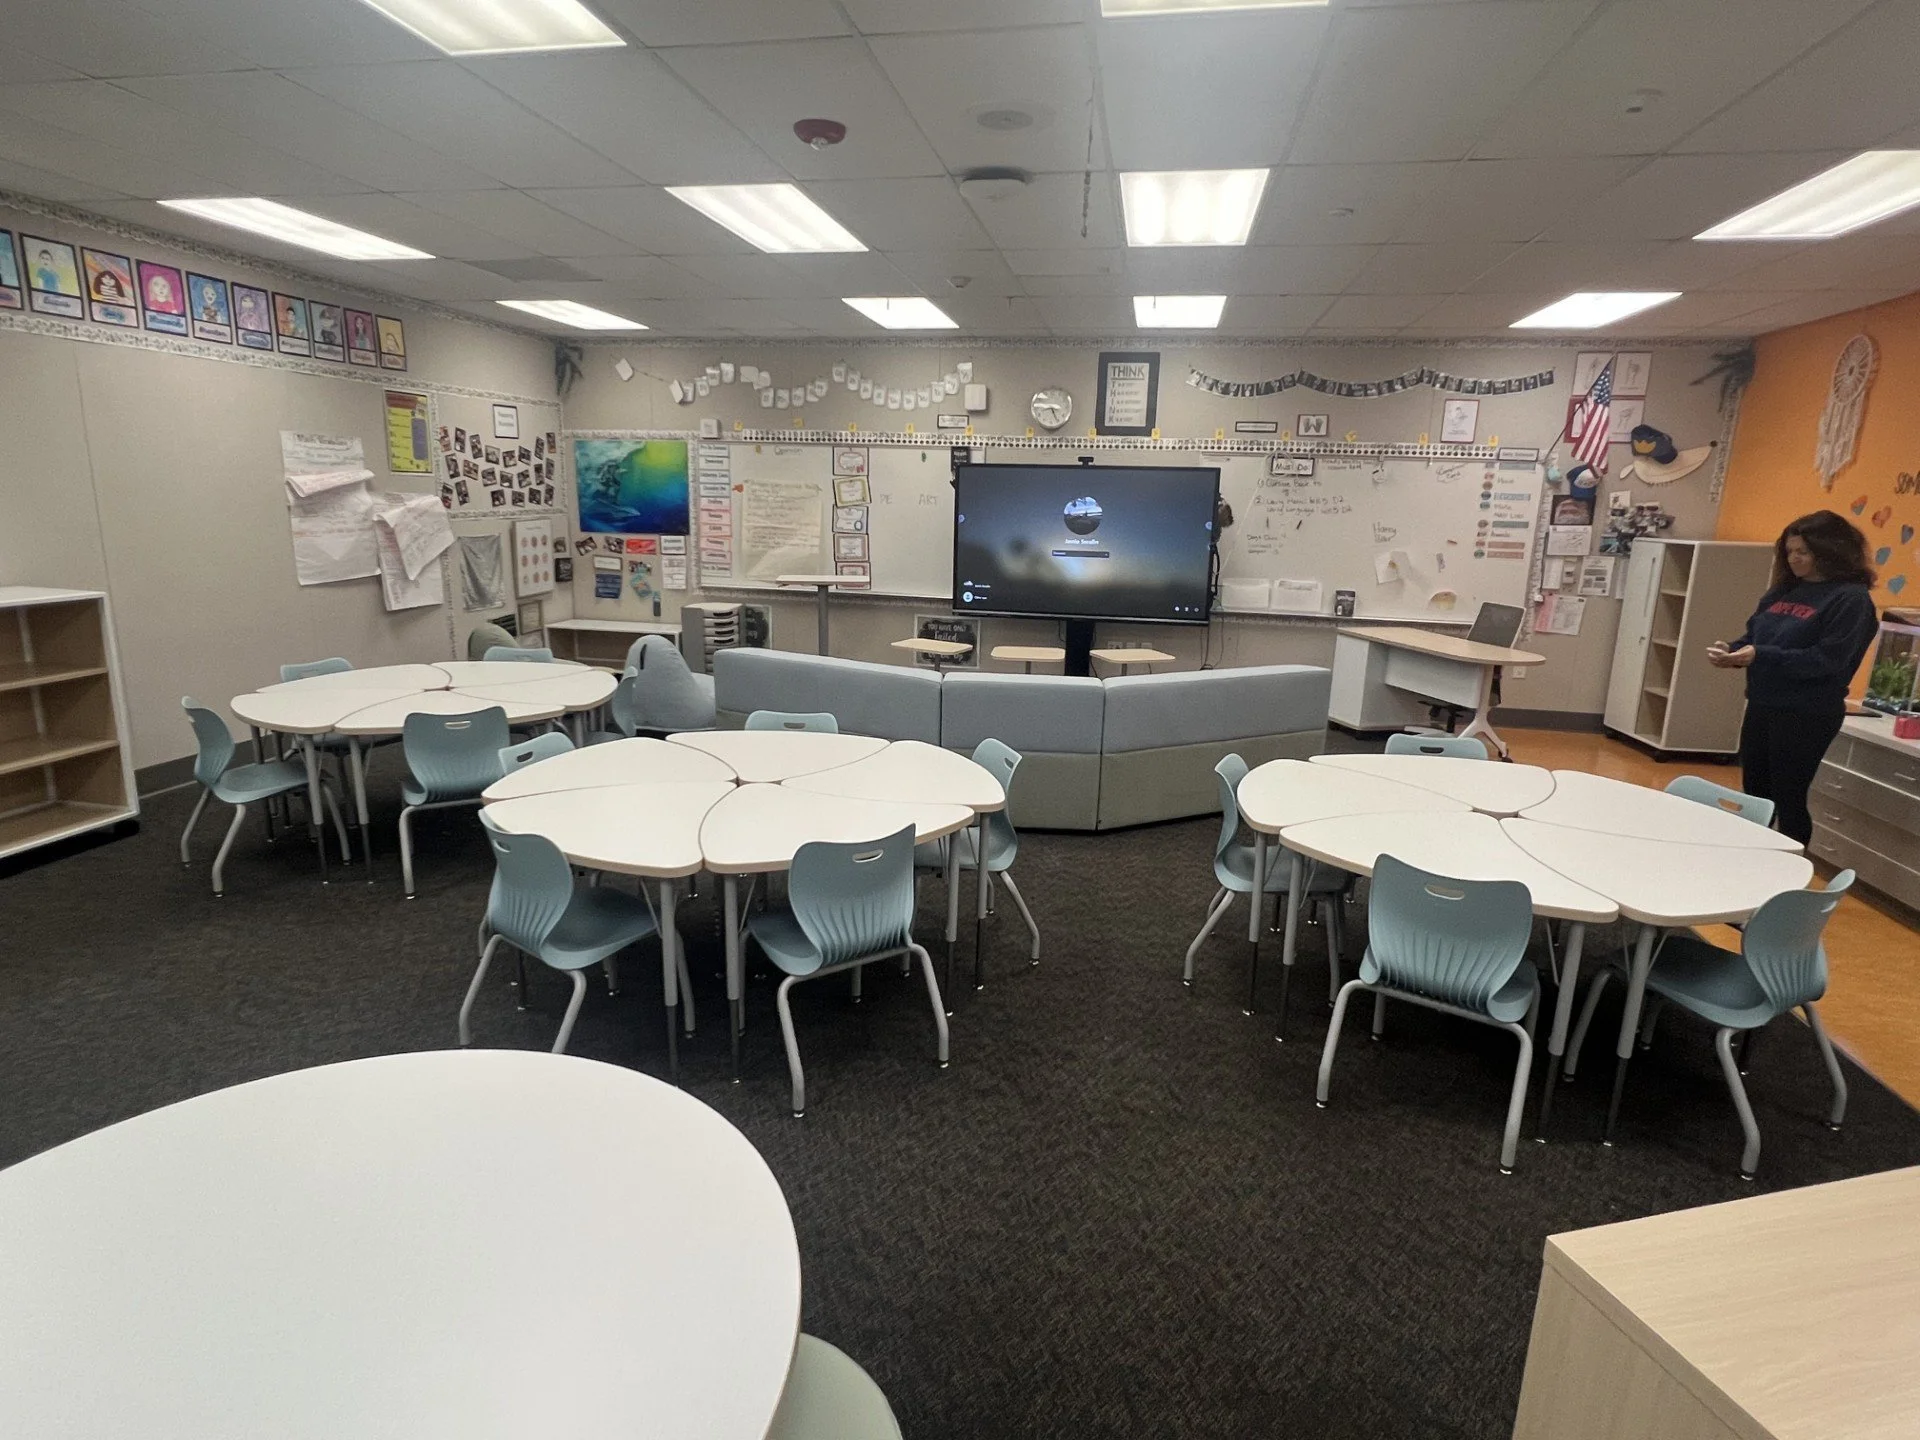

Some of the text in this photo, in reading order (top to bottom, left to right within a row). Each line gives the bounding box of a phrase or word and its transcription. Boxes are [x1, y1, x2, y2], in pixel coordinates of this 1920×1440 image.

[1111, 365, 1145, 378] THINK
[880, 493, 893, 504] PE
[918, 493, 939, 506] ART
